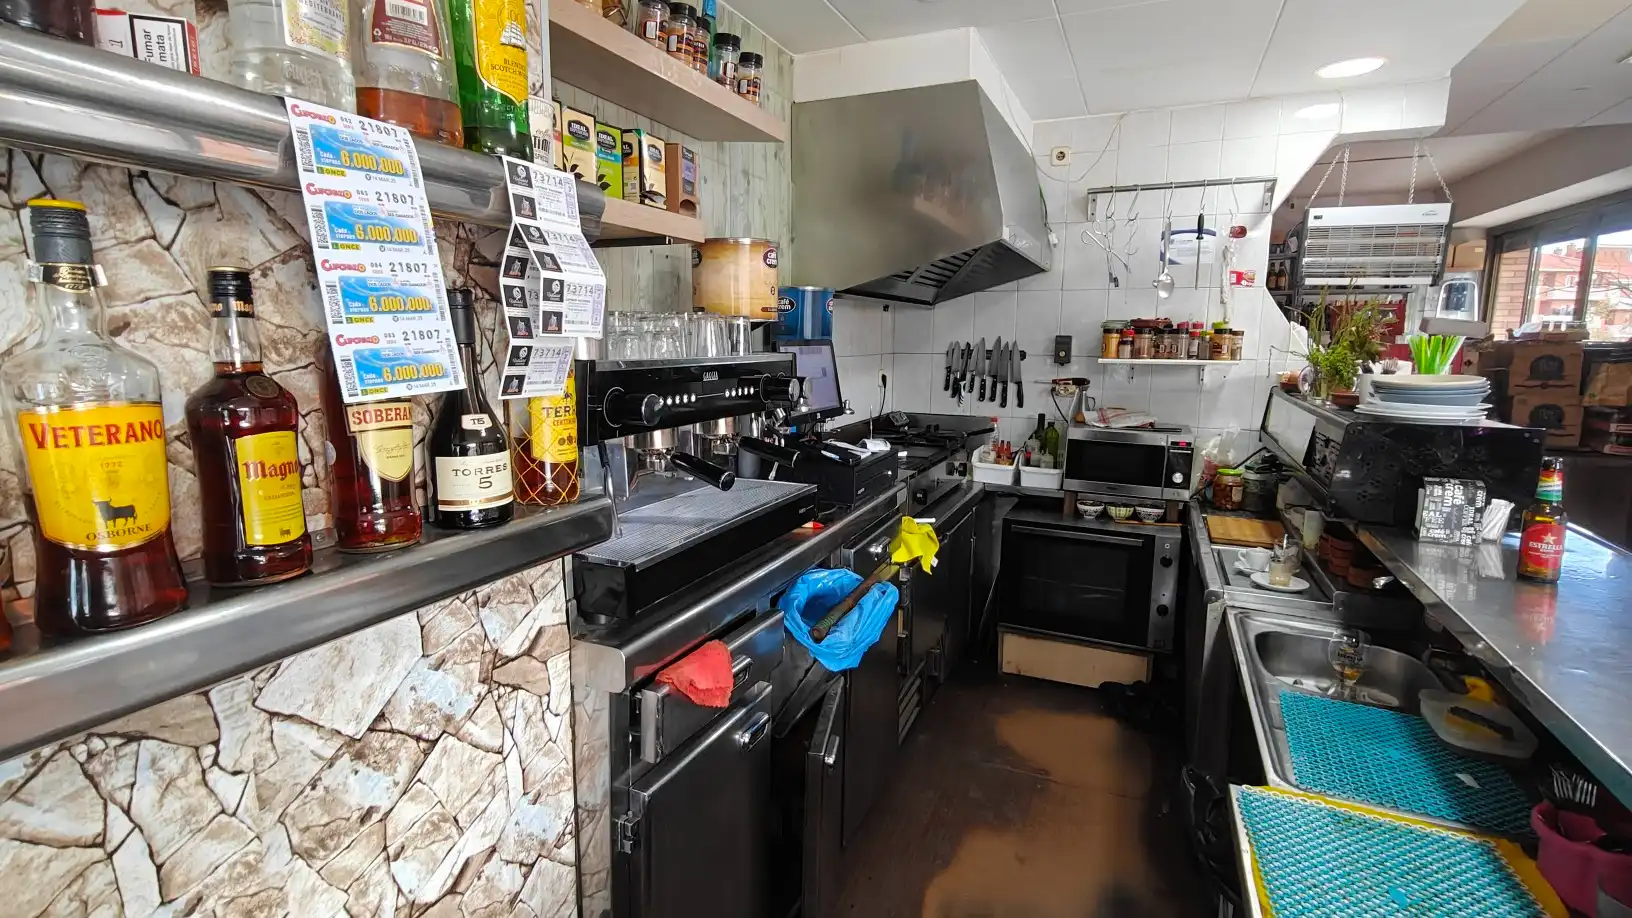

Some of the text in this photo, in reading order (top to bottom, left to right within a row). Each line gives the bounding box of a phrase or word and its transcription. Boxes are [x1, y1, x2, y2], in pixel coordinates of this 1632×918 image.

[156, 34, 168, 62] mata
[490, 63, 517, 74] SCOTCH
[358, 120, 399, 138] 21807
[571, 122, 587, 132] IDEAL
[598, 132, 613, 142] IDEAL
[325, 168, 346, 177] ONCE
[533, 171, 564, 186] 73714
[375, 190, 414, 205] 21807
[389, 262, 428, 273] 21807
[566, 284, 594, 294] 73714
[402, 330, 441, 341] 21807
[533, 348, 562, 357] 73714
[469, 417, 485, 425] T5
[28, 418, 164, 449] VETERANO
[452, 462, 508, 477] TORRES
[478, 476, 493, 489] 5
[1453, 484, 1464, 505] café
[86, 524, 152, 541] OSBORNE
[1528, 542, 1563, 550] ESTRELLA
